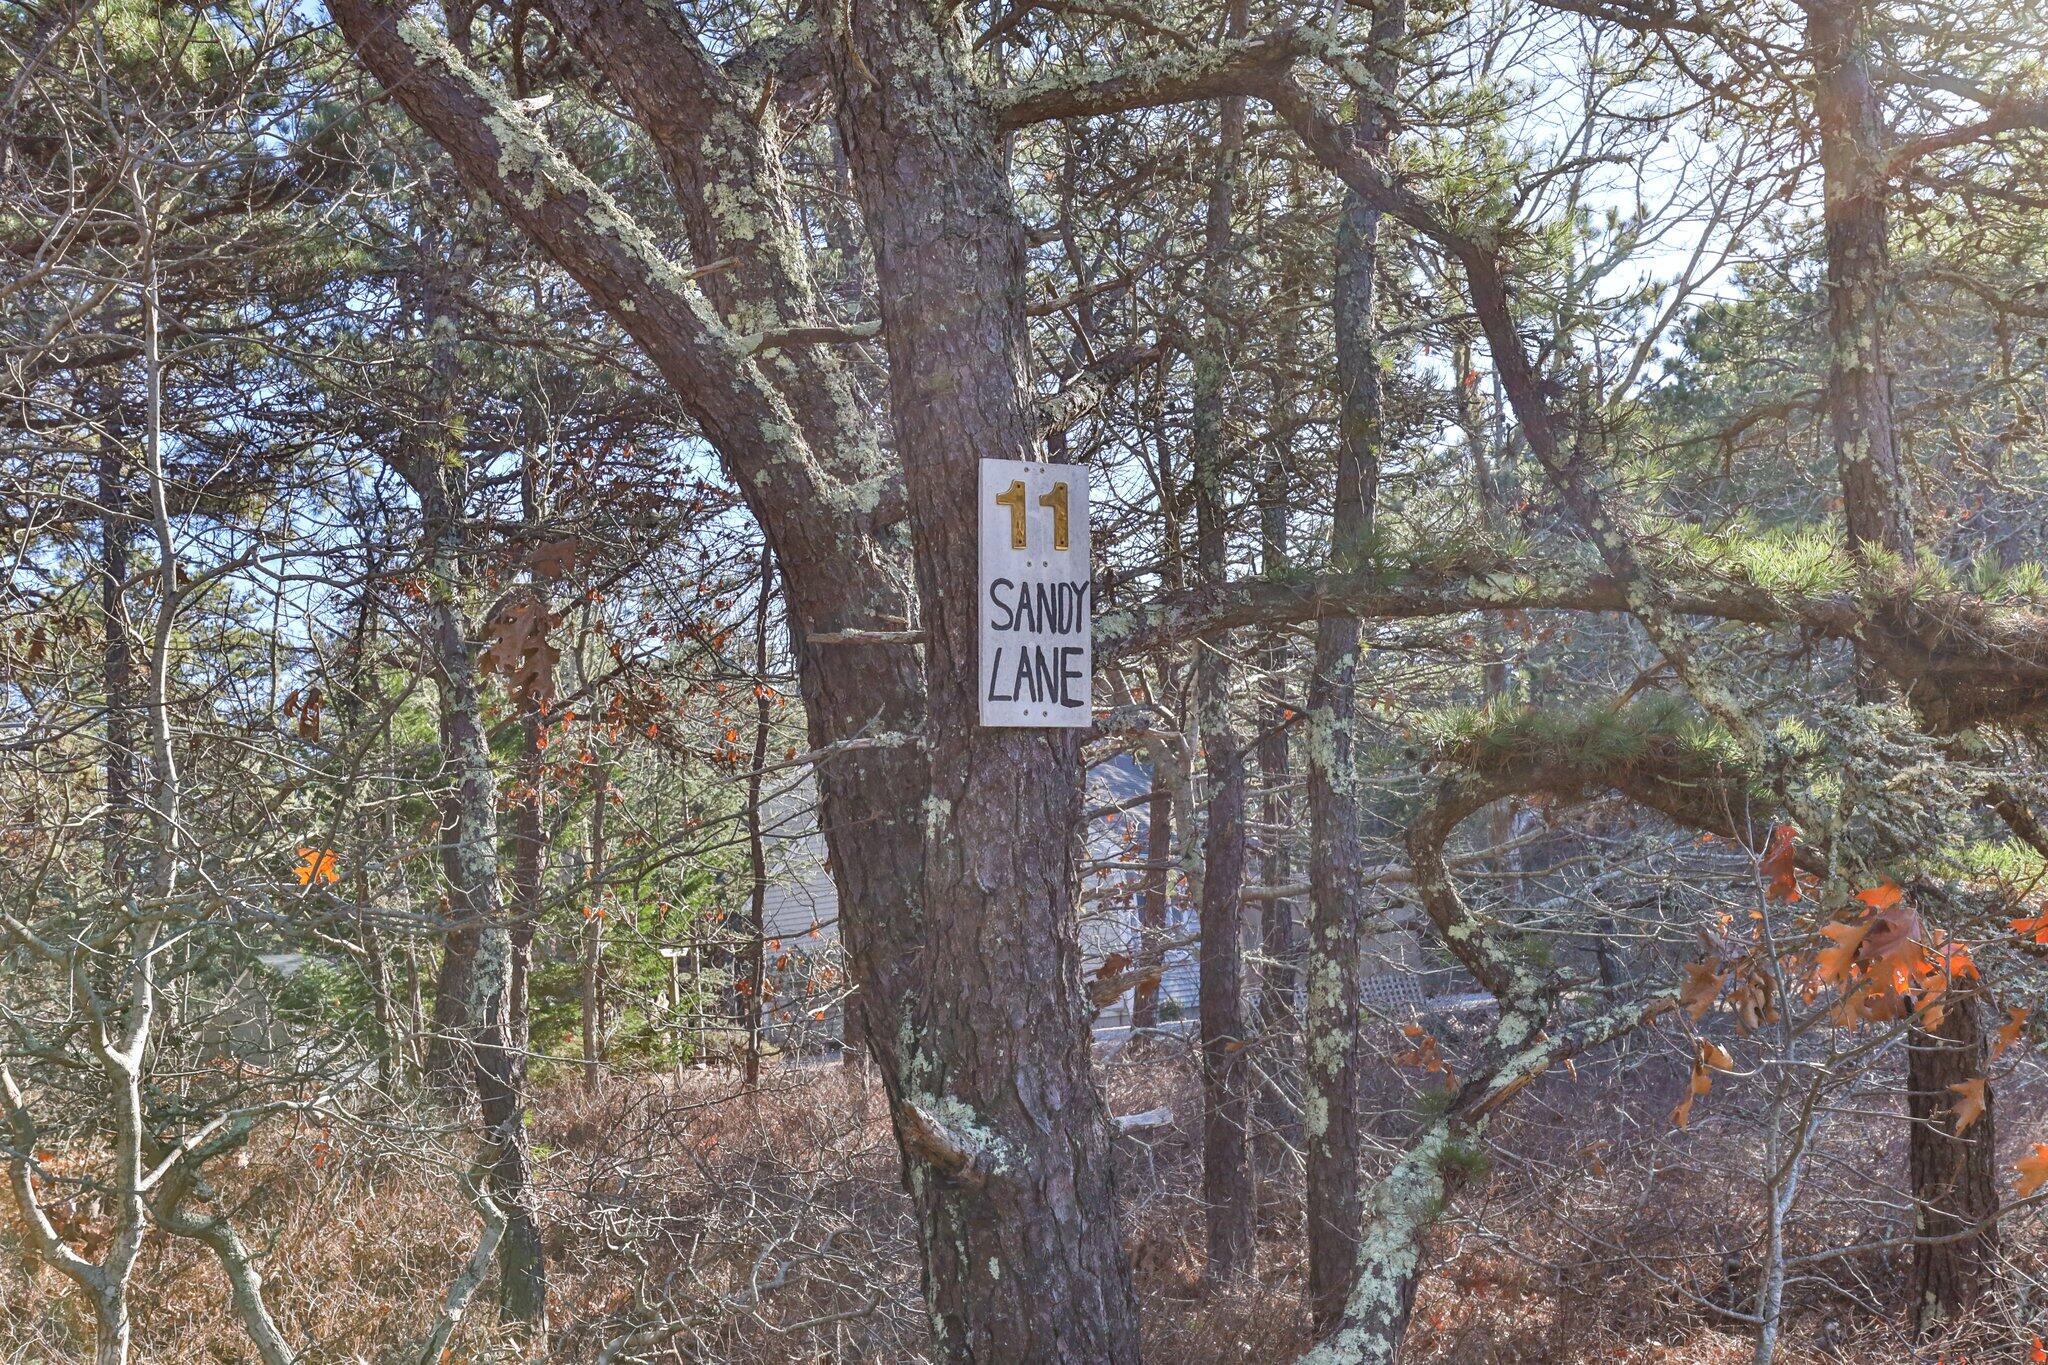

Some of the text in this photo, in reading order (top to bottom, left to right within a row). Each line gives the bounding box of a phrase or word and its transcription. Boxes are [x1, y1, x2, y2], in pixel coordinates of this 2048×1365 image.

[996, 479, 1069, 550] 11
[989, 577, 1090, 635] SANDY
[988, 645, 1084, 708] LANE
